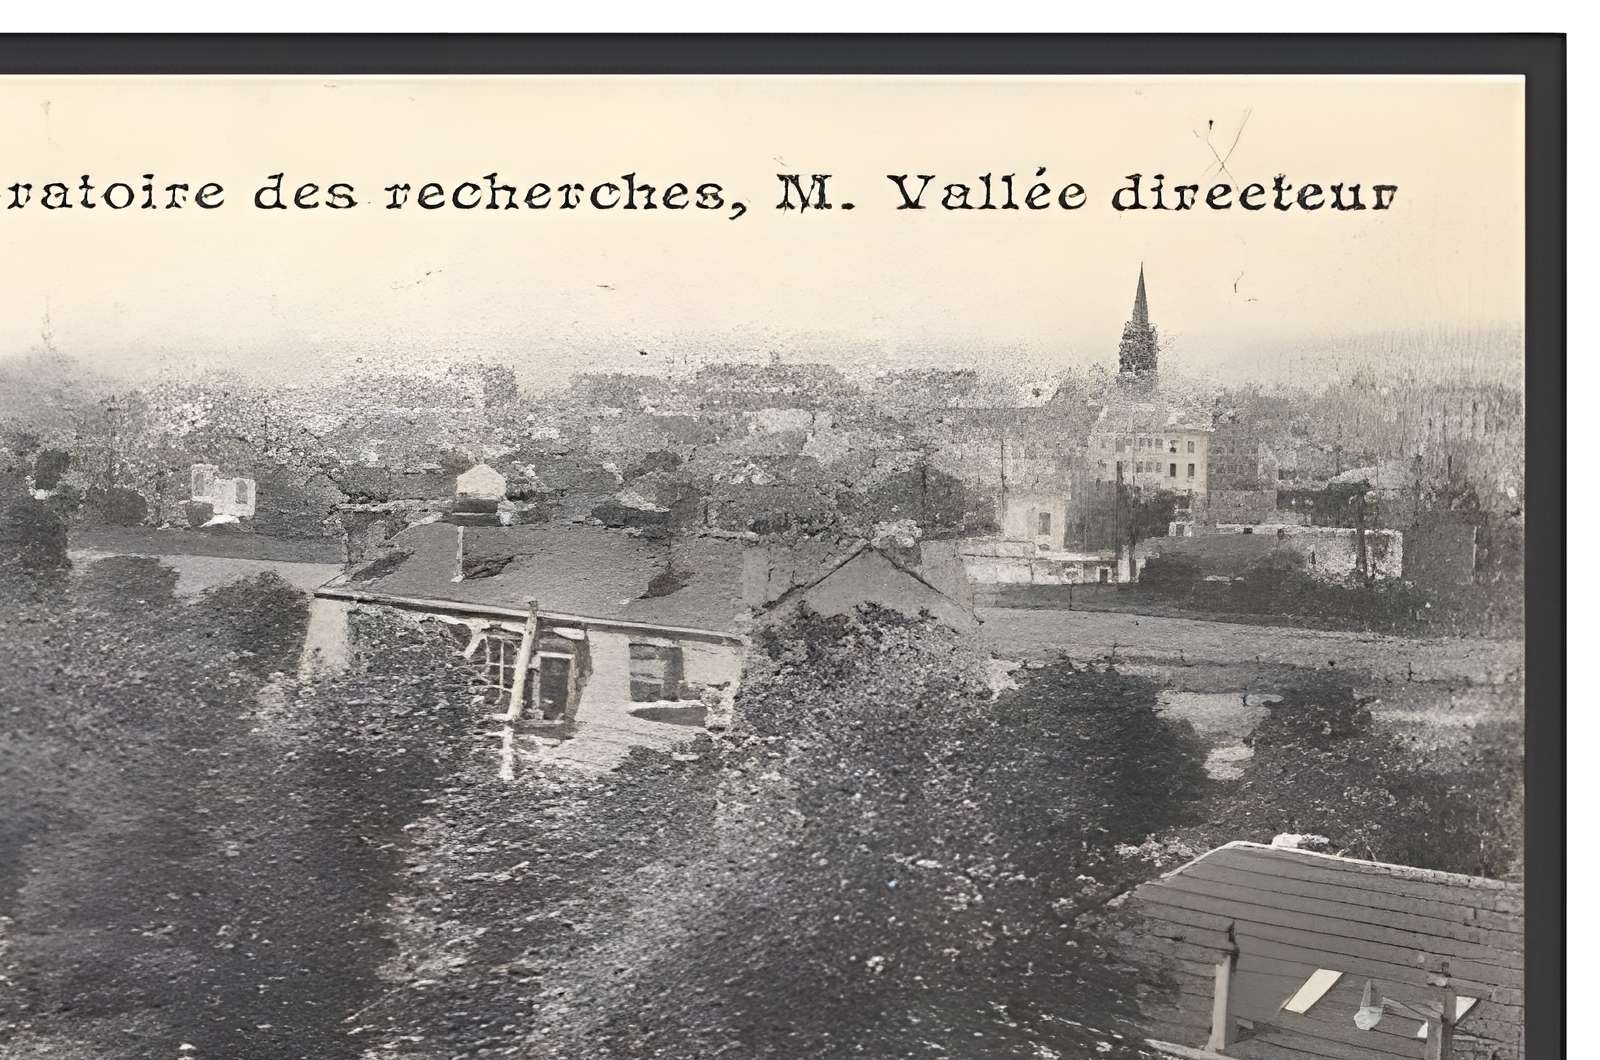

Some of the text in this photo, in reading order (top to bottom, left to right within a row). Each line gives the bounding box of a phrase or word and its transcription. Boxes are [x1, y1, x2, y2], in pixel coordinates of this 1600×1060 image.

[254, 172, 358, 210] des
[384, 171, 747, 221] recherches,
[775, 173, 856, 214] M.
[886, 166, 1087, 211] Vallée
